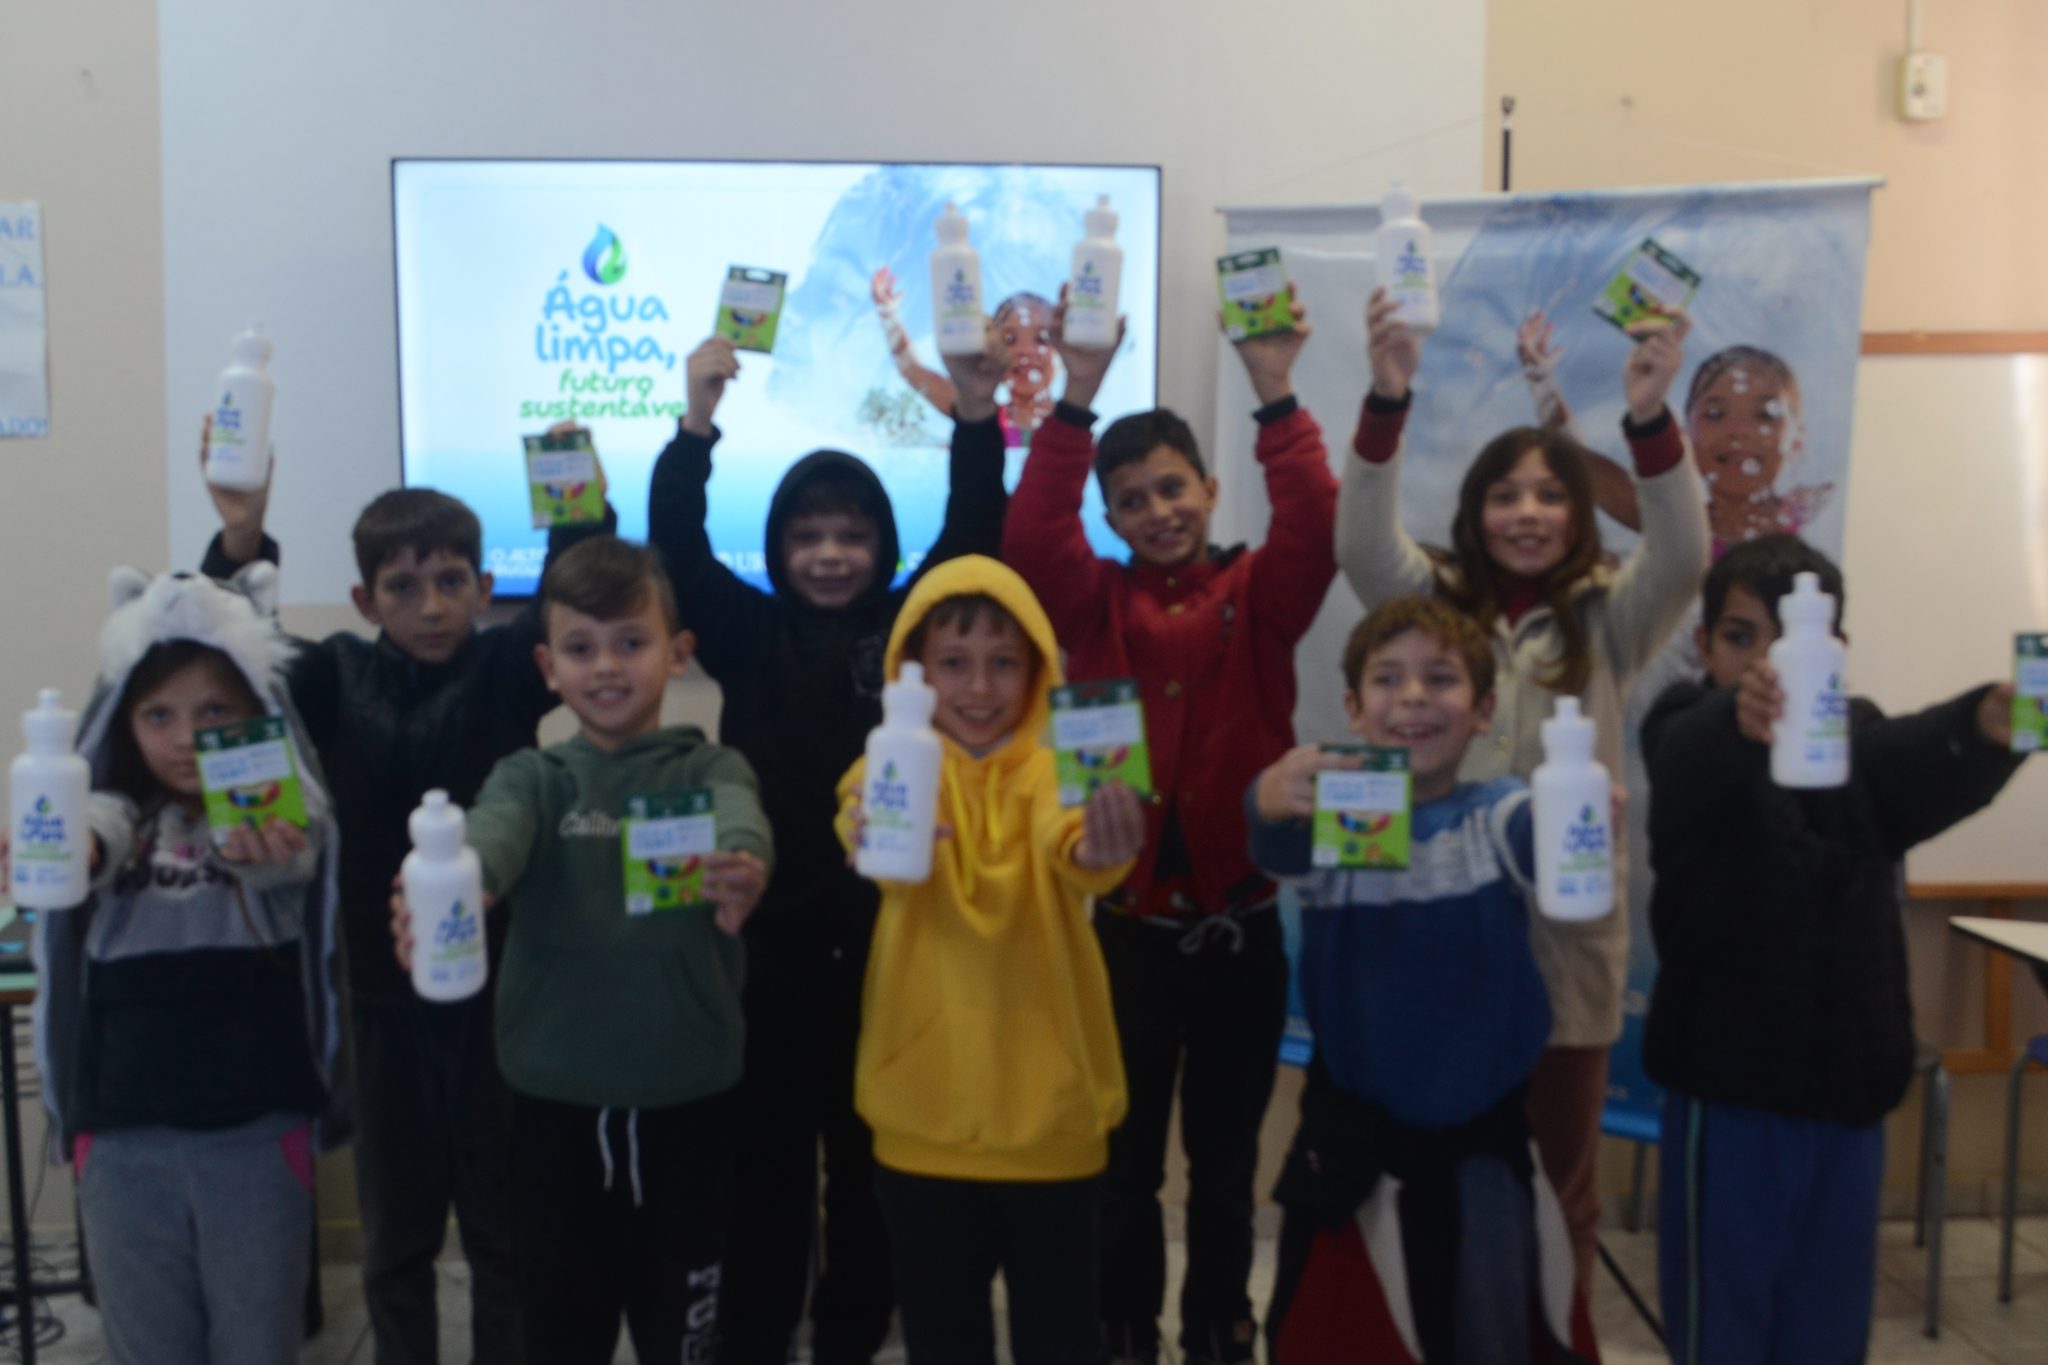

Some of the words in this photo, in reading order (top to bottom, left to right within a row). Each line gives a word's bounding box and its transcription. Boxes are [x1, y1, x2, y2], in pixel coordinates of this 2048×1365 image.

[543, 269, 669, 333] Água
[535, 324, 675, 373] limpa,
[559, 369, 653, 393] futuro
[519, 391, 686, 418] sustentáve
